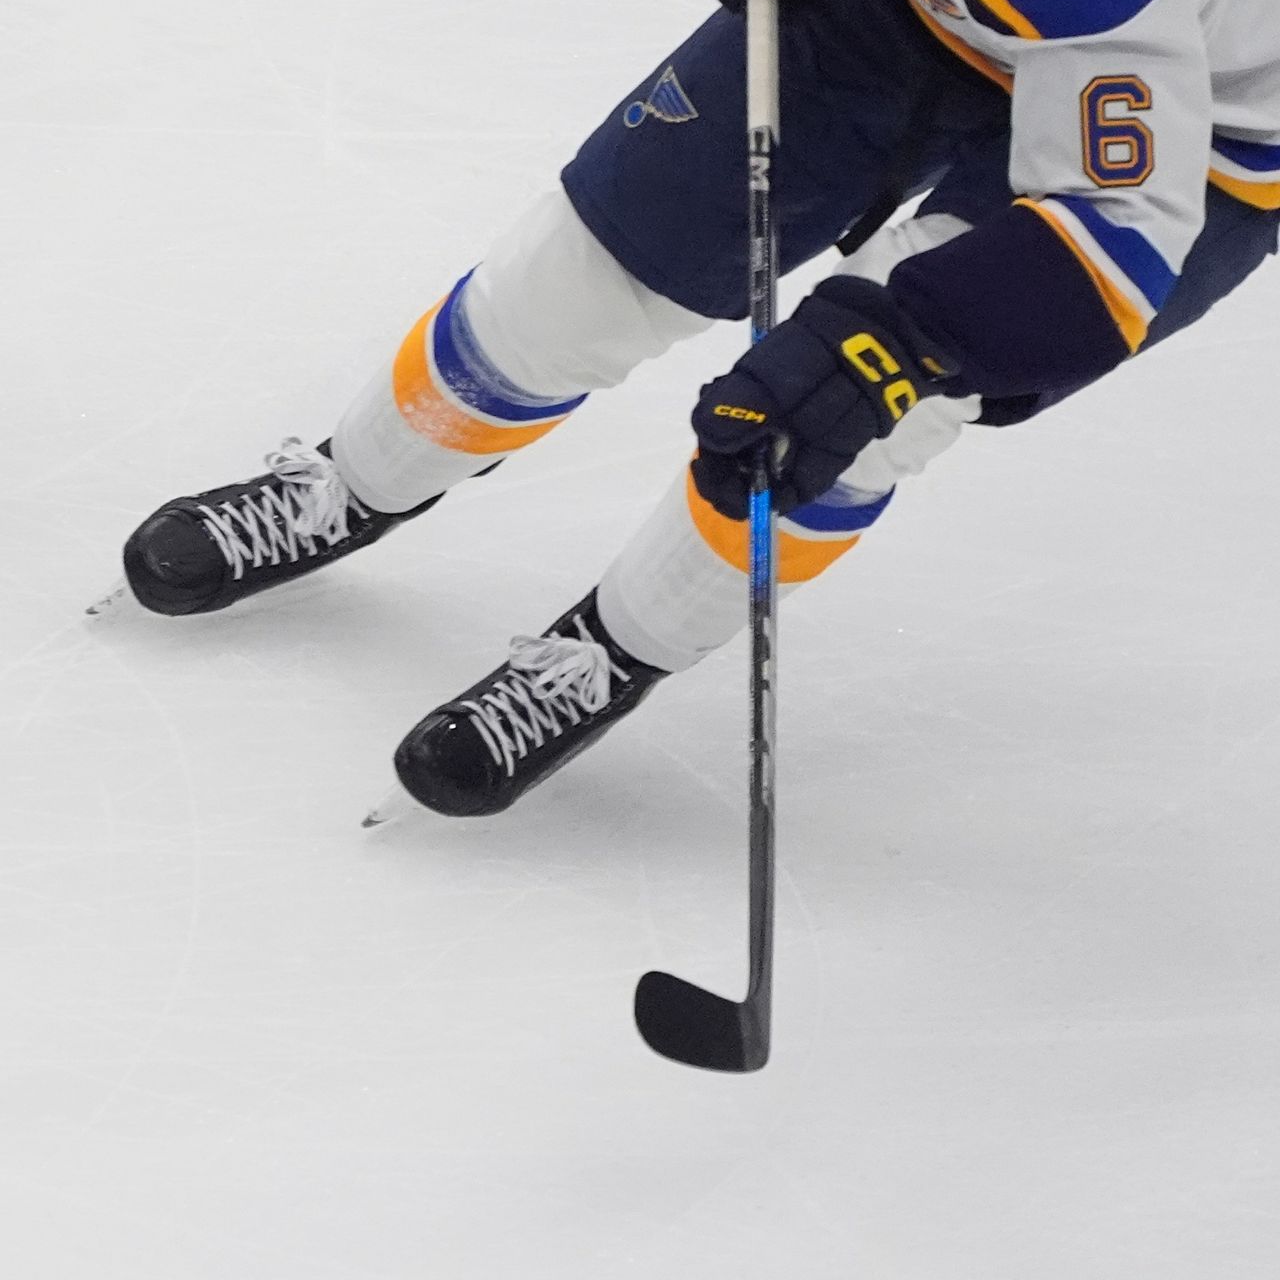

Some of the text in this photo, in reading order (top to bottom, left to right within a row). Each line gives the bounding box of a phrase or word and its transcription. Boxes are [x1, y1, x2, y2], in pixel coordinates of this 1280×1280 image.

[748, 126, 771, 191] CM
[1080, 75, 1154, 187] 6
[713, 404, 766, 424] CCM
[841, 332, 918, 421] CC
